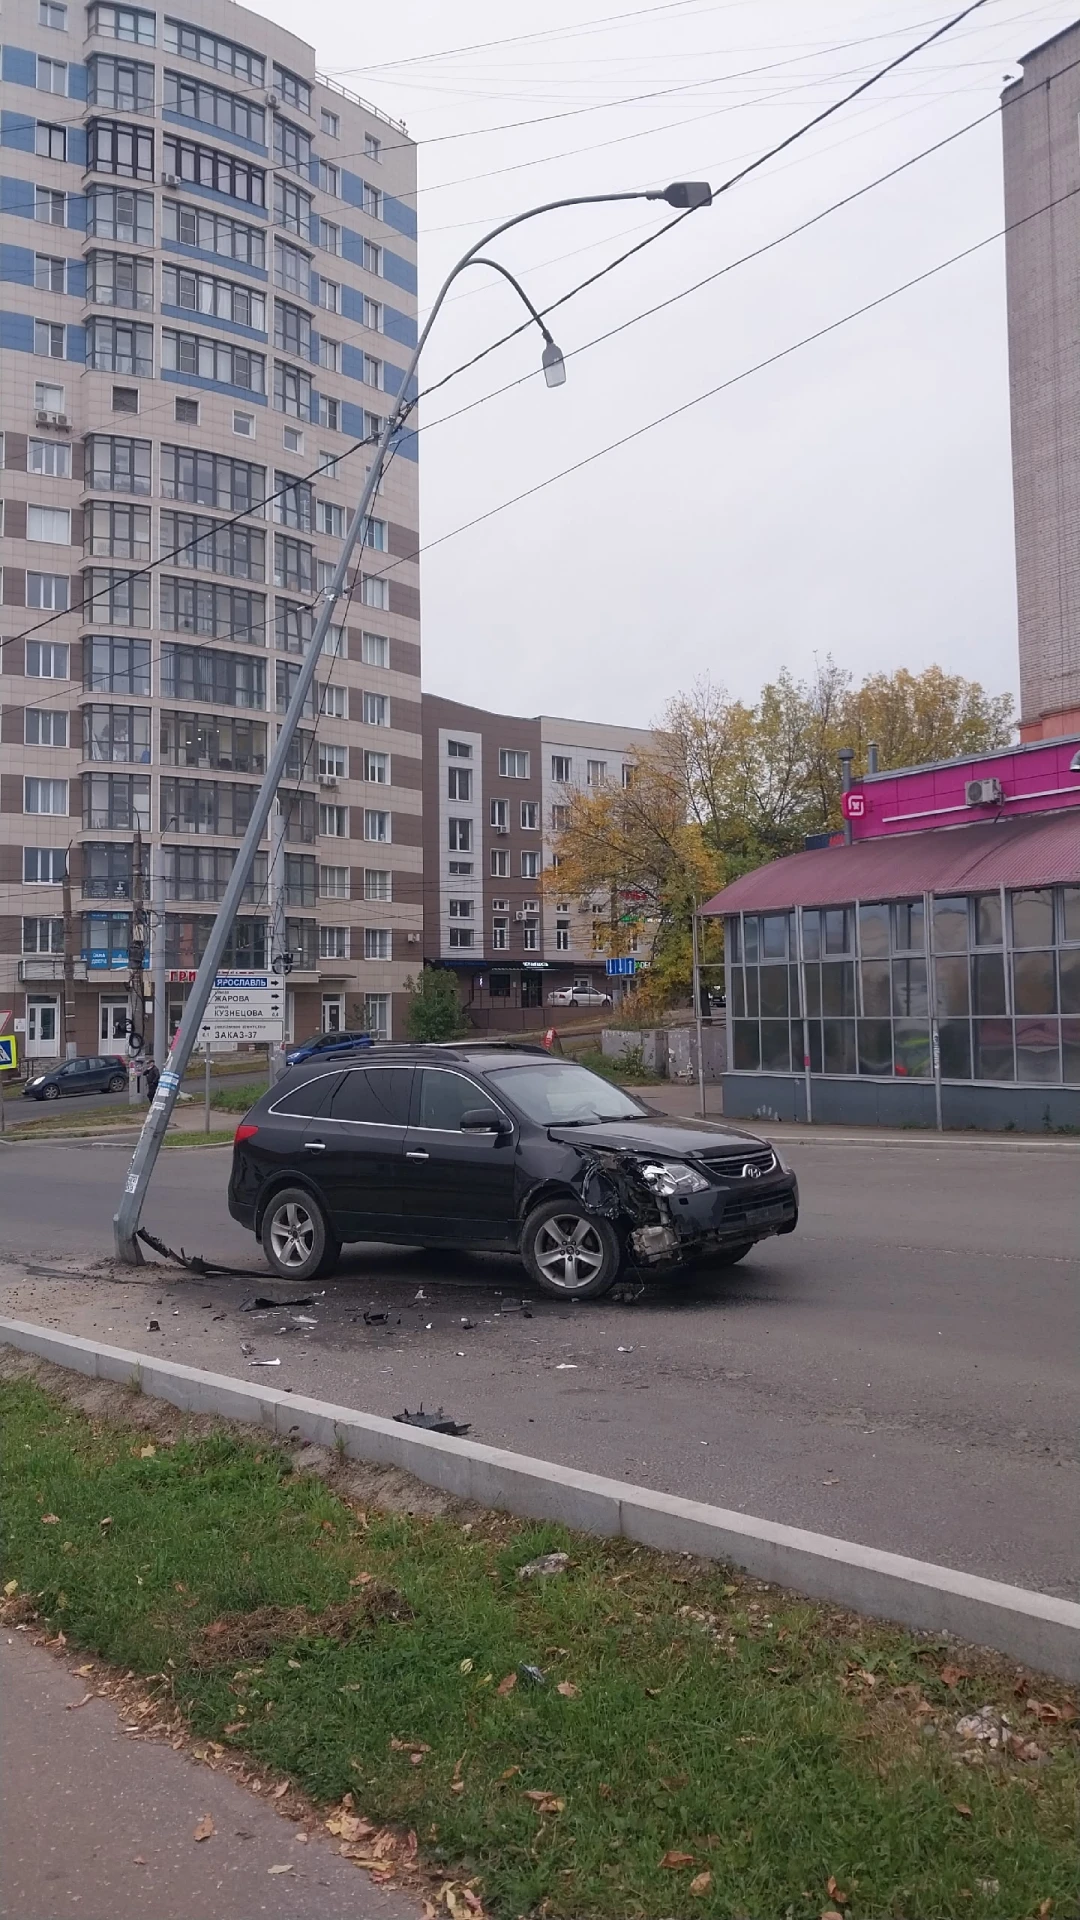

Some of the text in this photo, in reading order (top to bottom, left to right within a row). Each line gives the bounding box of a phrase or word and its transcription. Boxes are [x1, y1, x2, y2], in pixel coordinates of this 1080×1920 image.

[216, 978, 267, 987] ЯРОСЛАВЛЬ
[214, 1009, 264, 1018] КУЗНЕЦОВА
[214, 1031, 258, 1039] ЗАКАЗ-37
